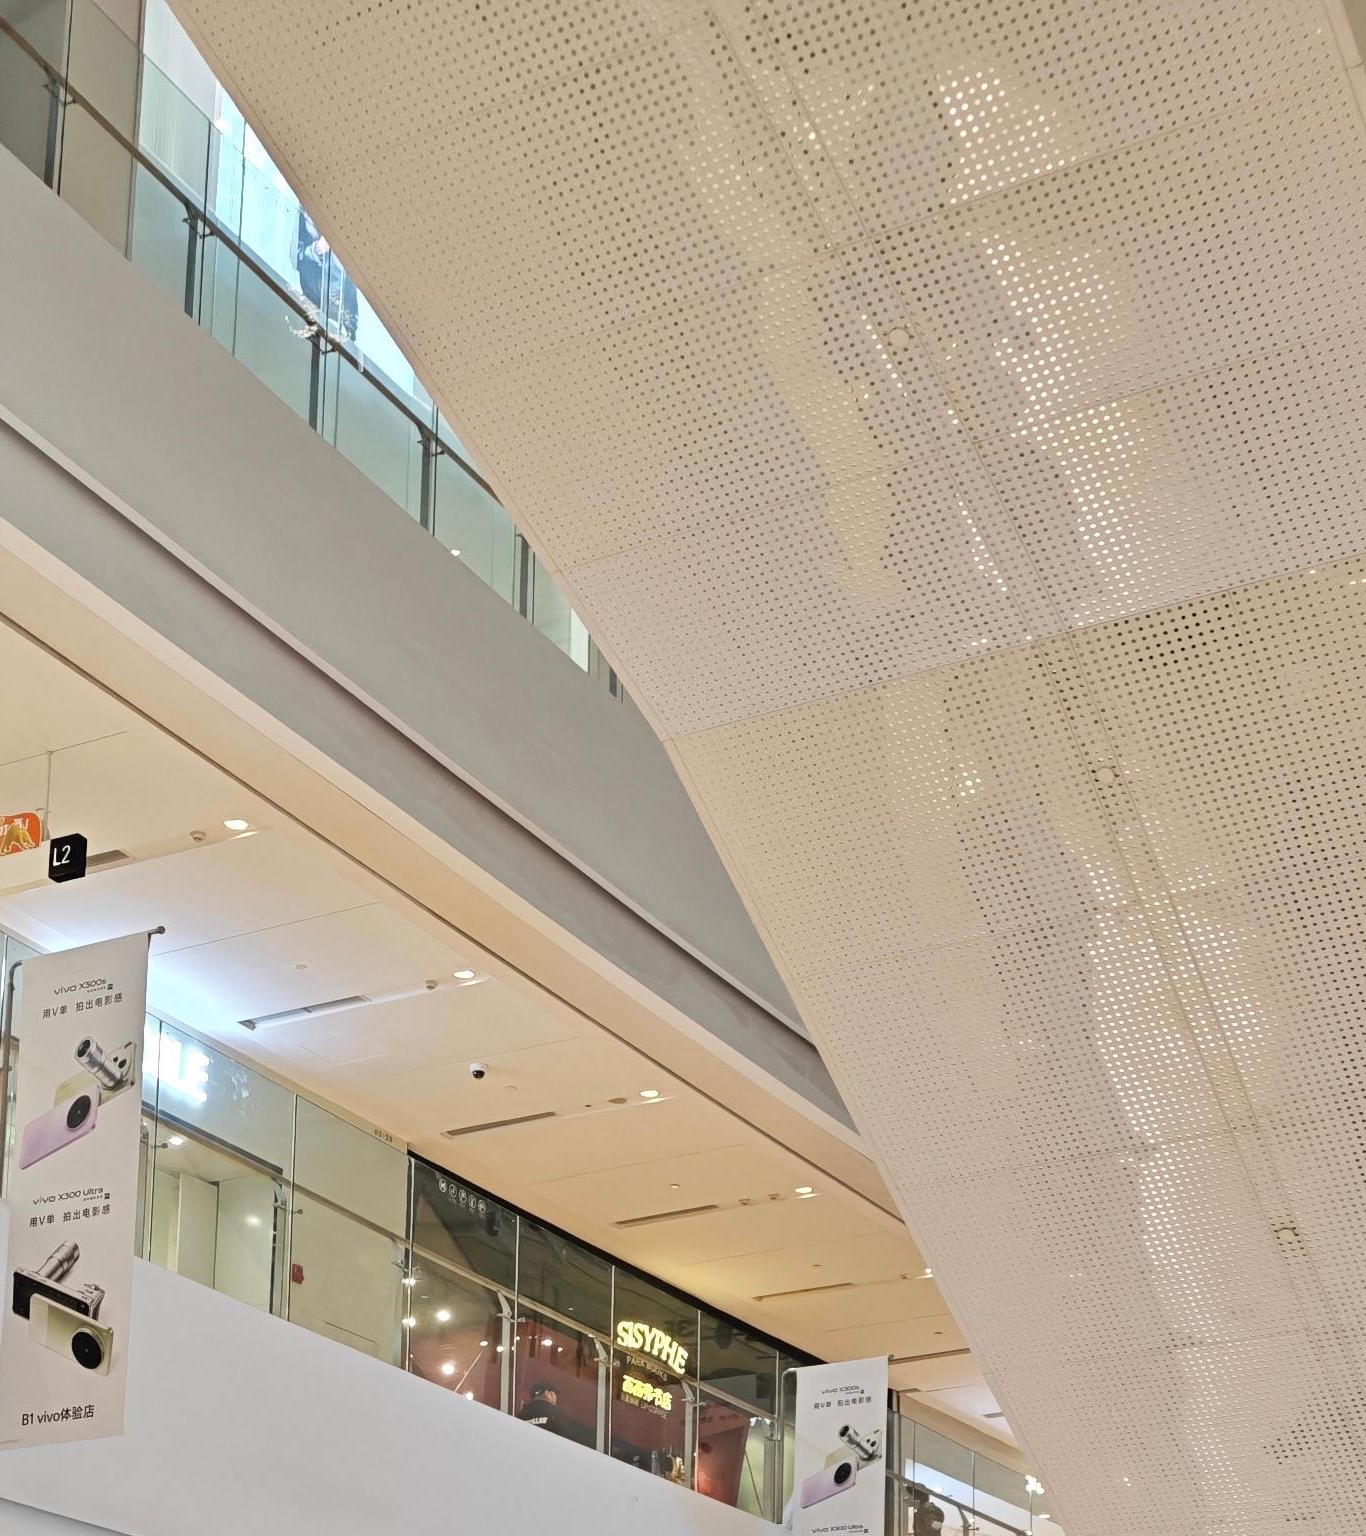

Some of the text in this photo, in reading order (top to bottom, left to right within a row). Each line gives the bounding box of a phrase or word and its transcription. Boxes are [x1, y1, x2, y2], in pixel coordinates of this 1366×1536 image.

[52, 844, 71, 867] L2
[53, 984, 77, 996] vivo
[78, 978, 107, 992] X300s
[32, 1194, 56, 1206] vivo
[57, 1190, 82, 1202] X300
[82, 1187, 104, 1197] Ultra
[616, 1320, 689, 1375] SISYPHE
[22, 1404, 95, 1426] B1 vivo体验店
